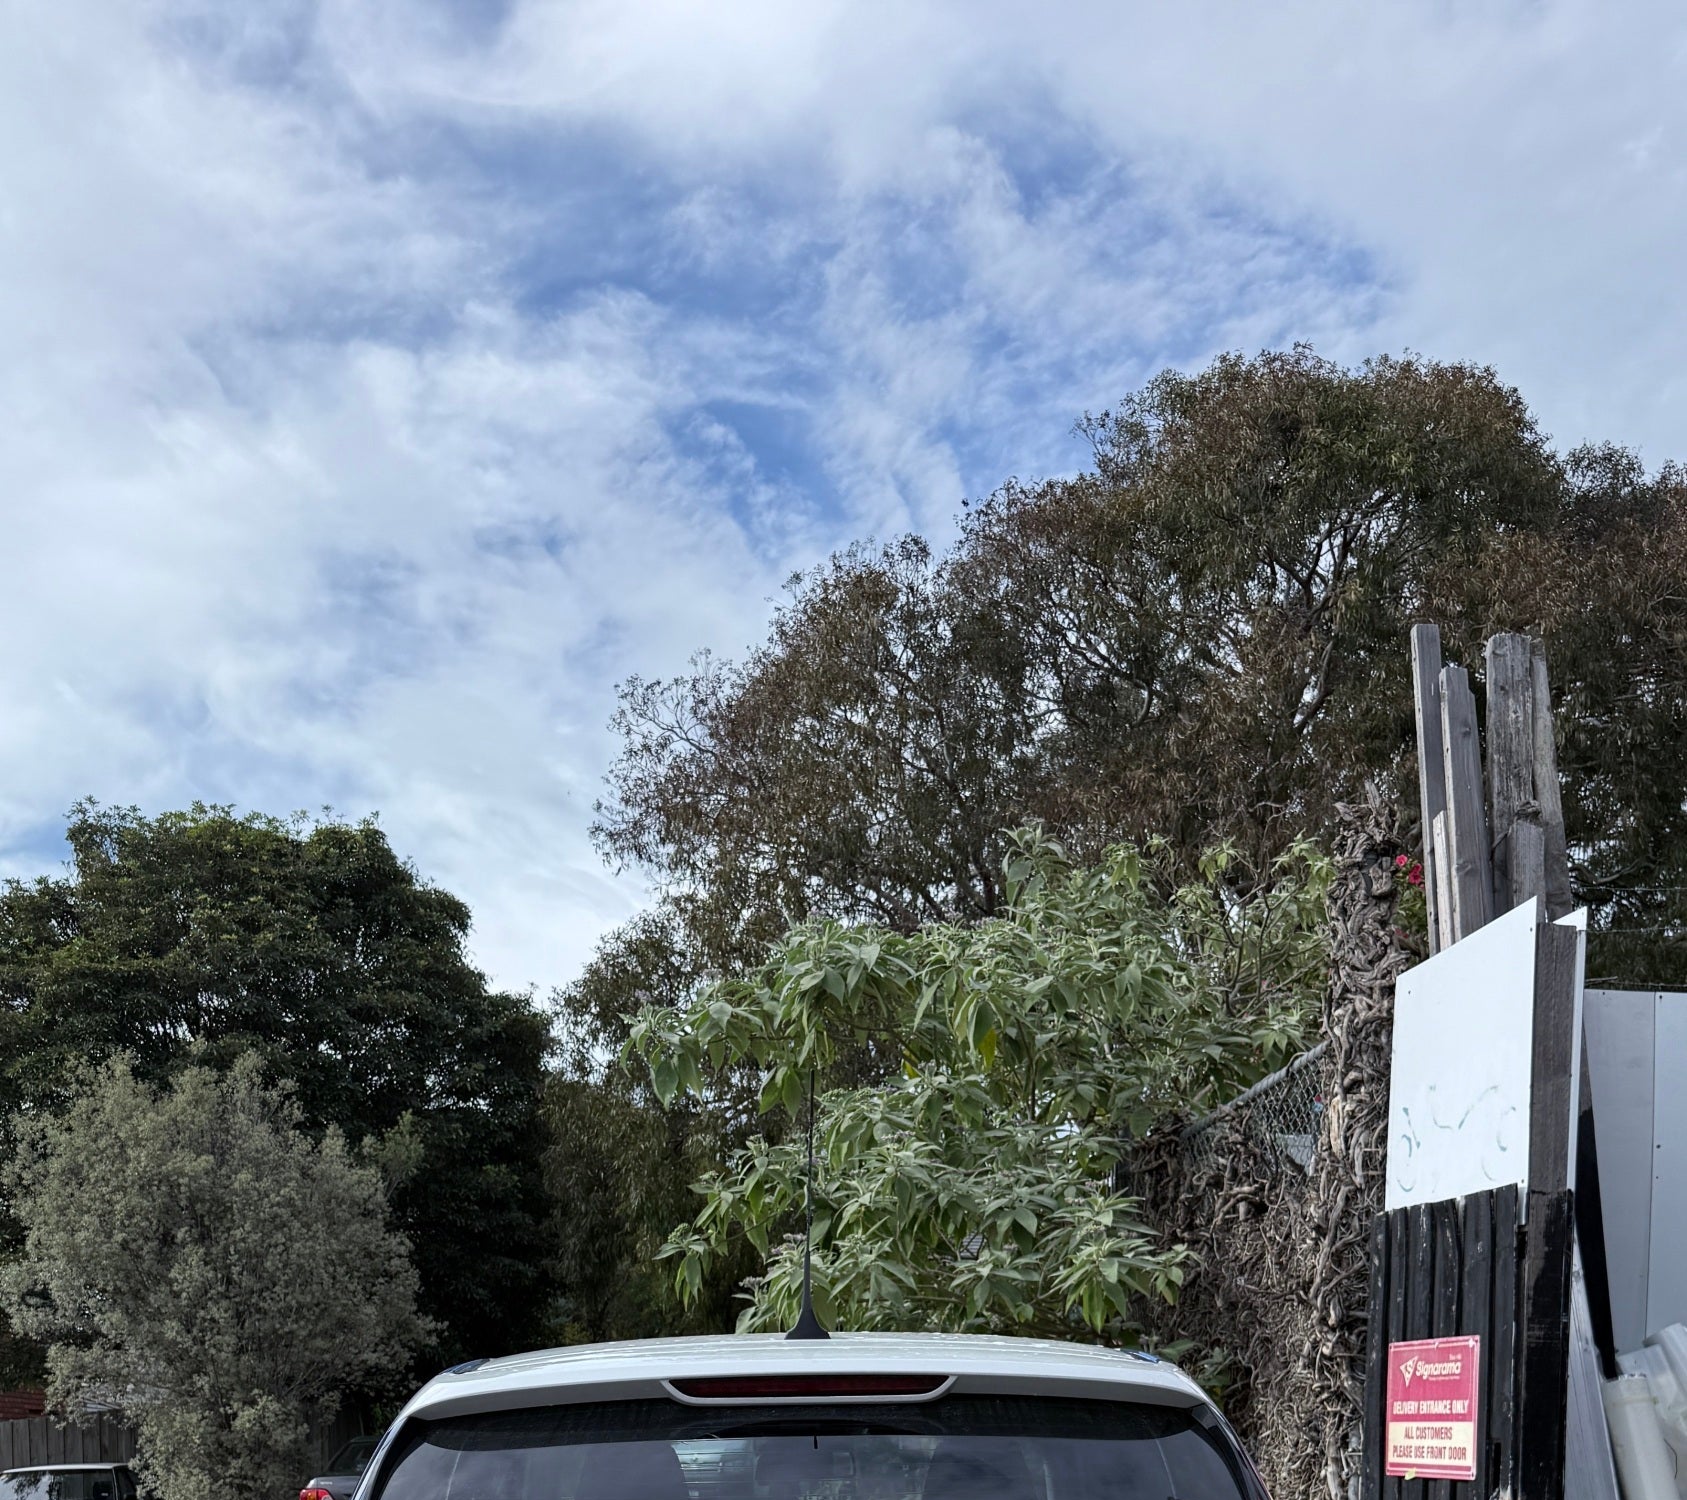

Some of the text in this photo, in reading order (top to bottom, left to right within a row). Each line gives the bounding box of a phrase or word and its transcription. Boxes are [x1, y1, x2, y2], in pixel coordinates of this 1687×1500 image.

[1415, 1361, 1461, 1380] Signarama
[1393, 1399, 1469, 1415] DELIVERY ENTRANCE ONLY
[1404, 1426, 1453, 1440] ALL CUSTOMERS
[1393, 1445, 1467, 1461] PLEASE USE FRONT DOOR
